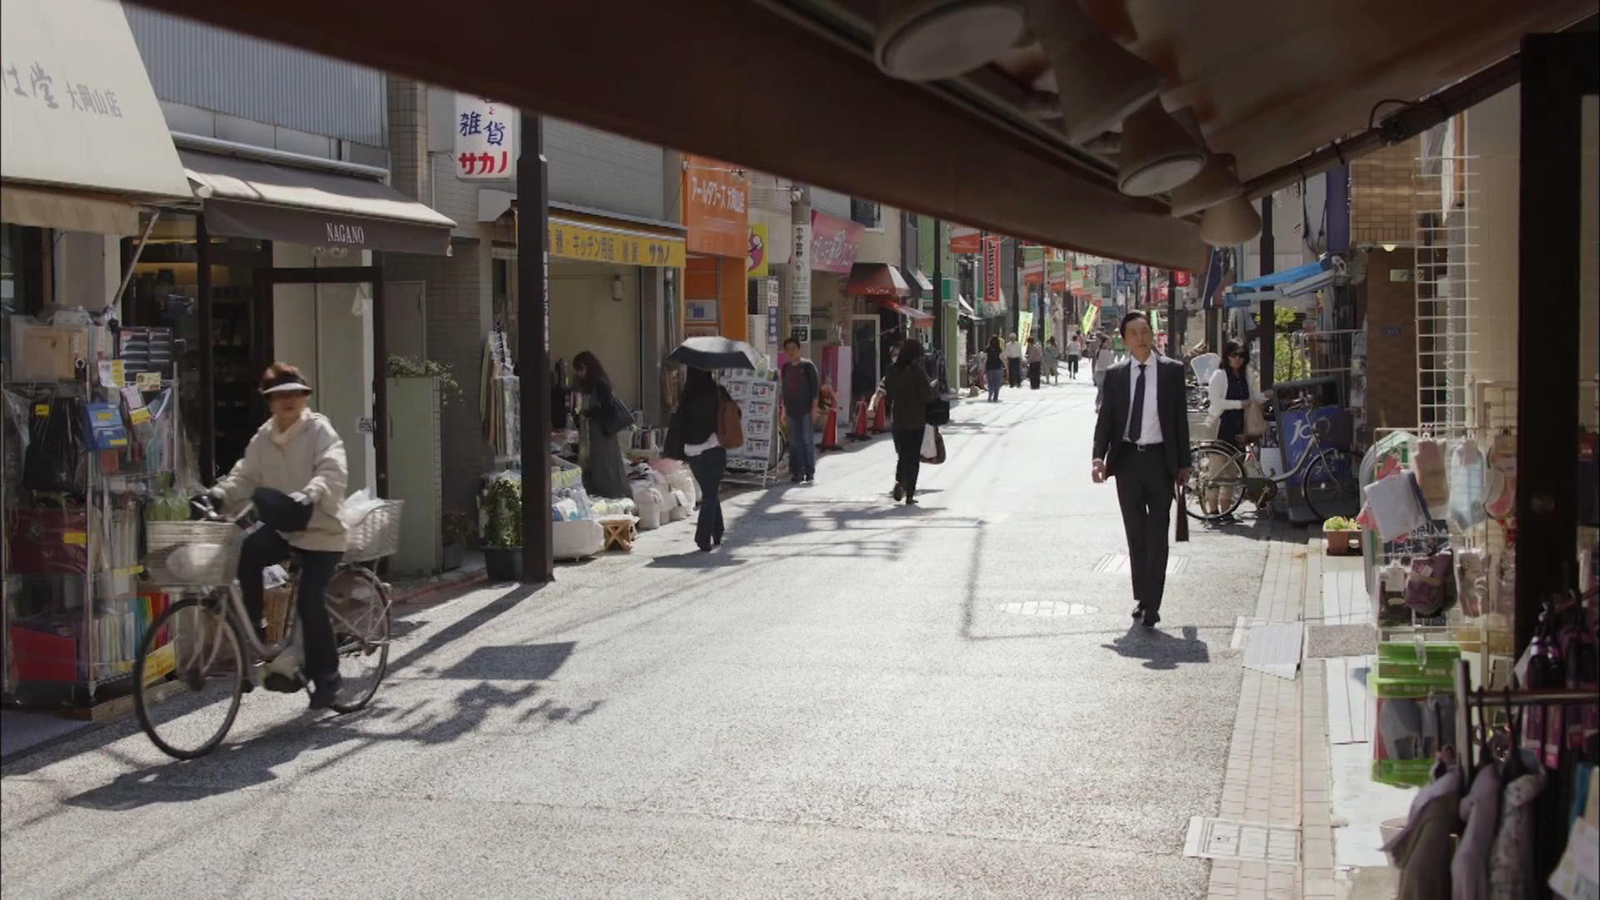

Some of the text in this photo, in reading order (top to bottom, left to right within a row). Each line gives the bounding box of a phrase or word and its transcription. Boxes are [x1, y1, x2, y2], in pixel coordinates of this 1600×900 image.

[459, 111, 506, 147] 雑貨
[458, 151, 507, 175] サカノ
[326, 222, 365, 244] NAGANO
[648, 243, 669, 264] サカノ
